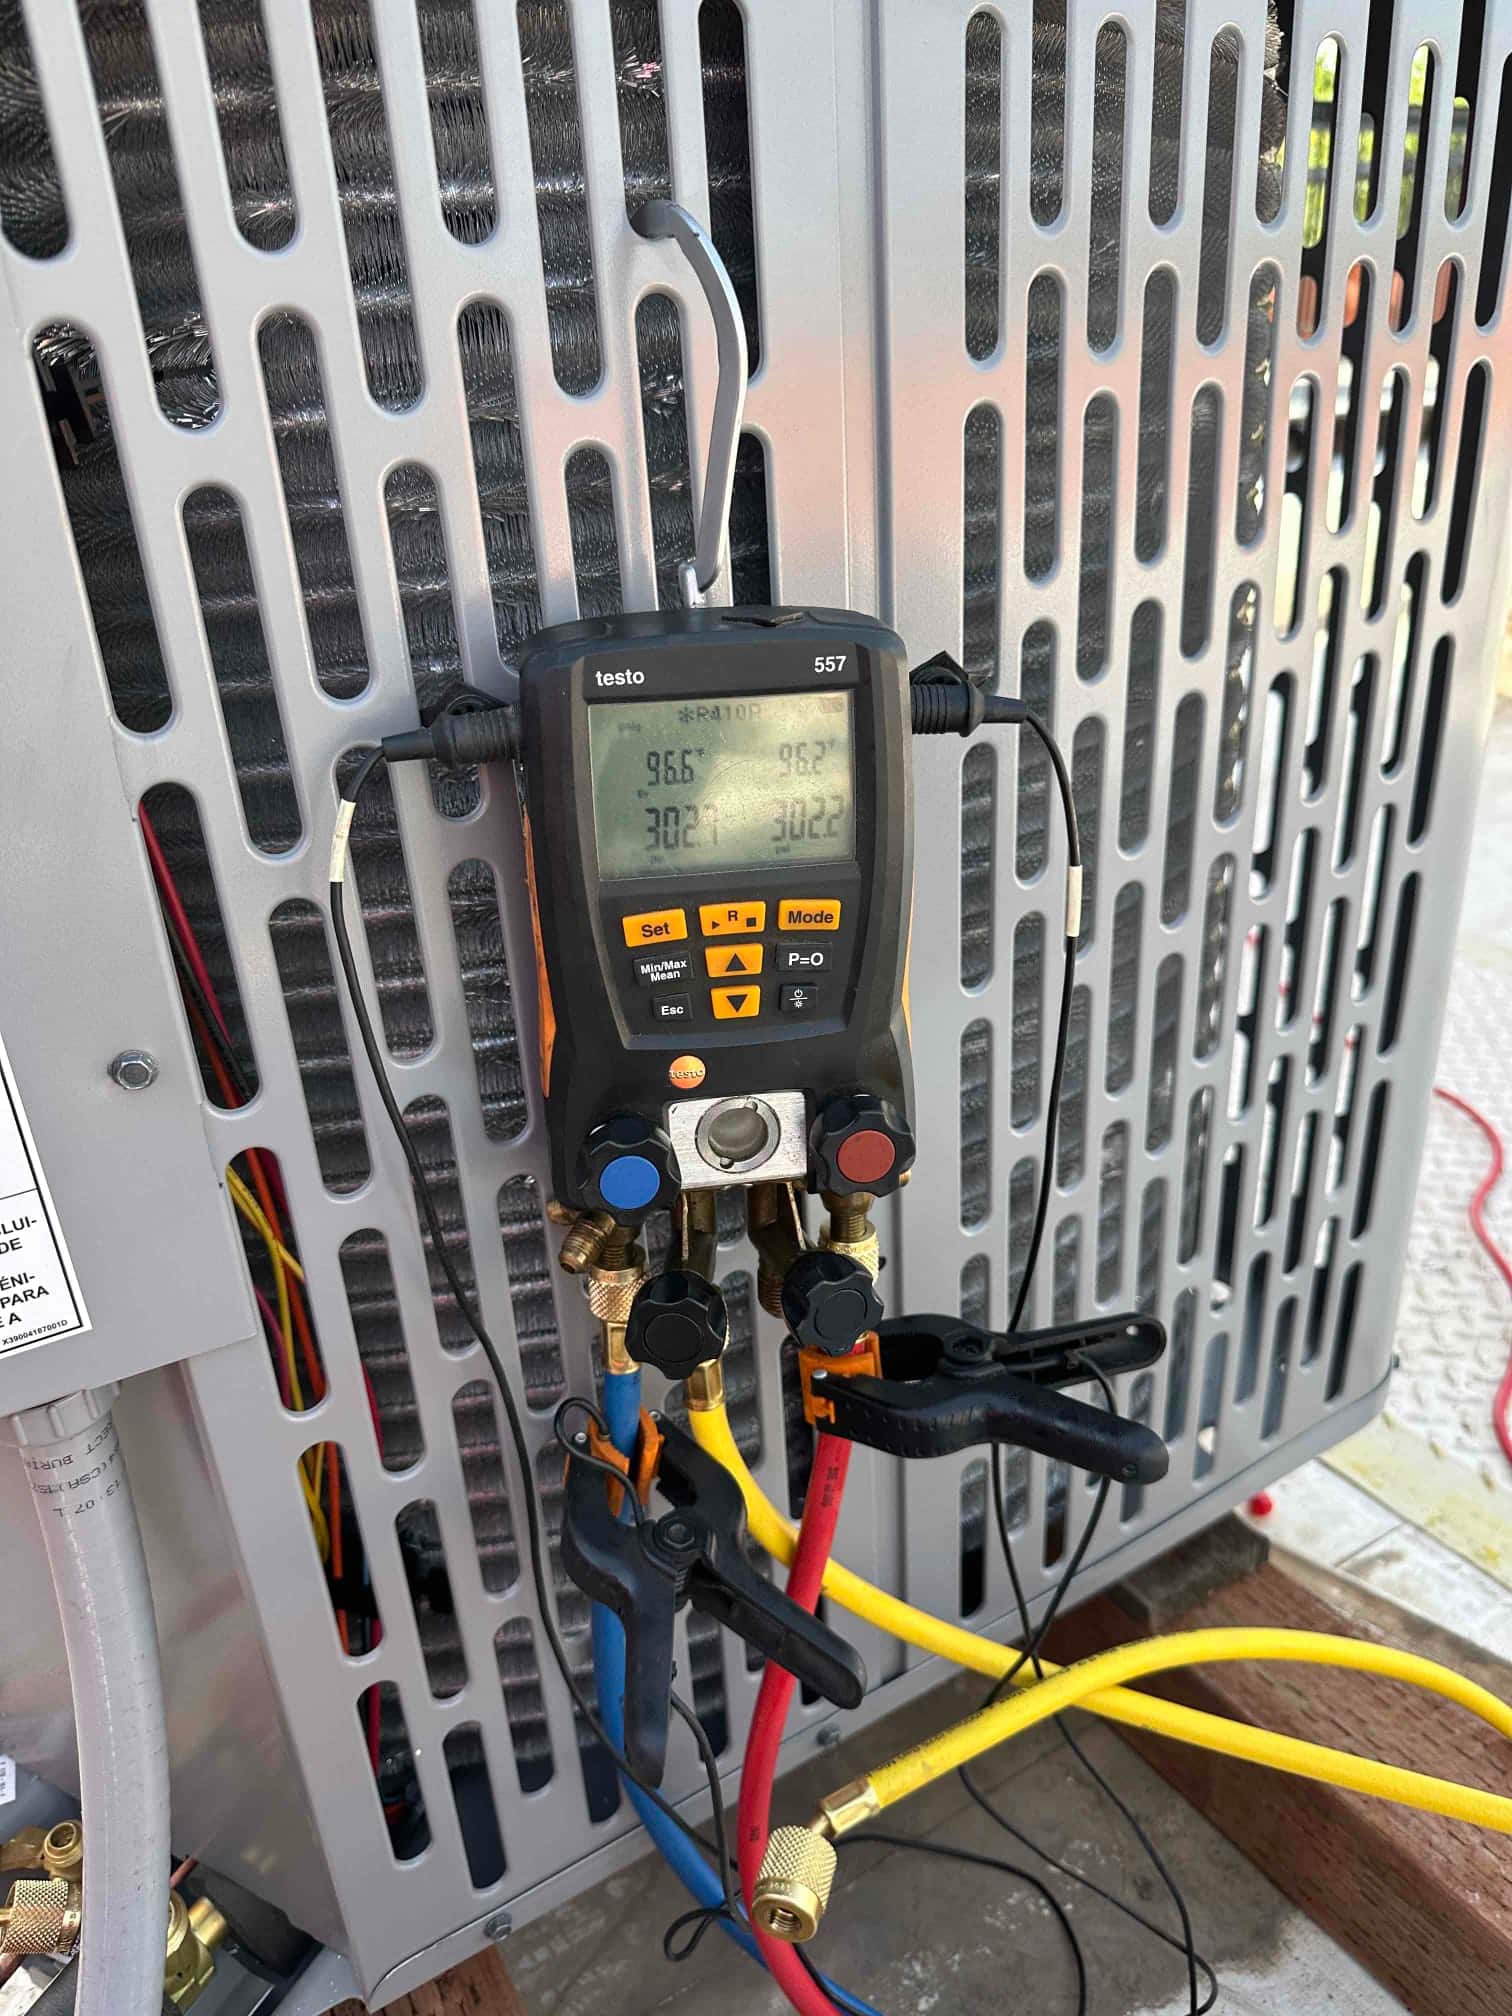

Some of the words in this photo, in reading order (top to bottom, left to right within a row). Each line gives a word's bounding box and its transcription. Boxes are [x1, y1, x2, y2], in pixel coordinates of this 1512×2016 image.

[813, 655, 847, 673] 557
[595, 668, 645, 687] testo
[727, 910, 739, 922] R
[788, 910, 834, 925] Mode
[641, 921, 671, 938] Set
[640, 959, 688, 975] Min/Max
[650, 969, 681, 983] Mean
[661, 1005, 684, 1016] Esc
[0, 1216, 37, 1236] LUI-
[0, 1286, 50, 1309] PARA
